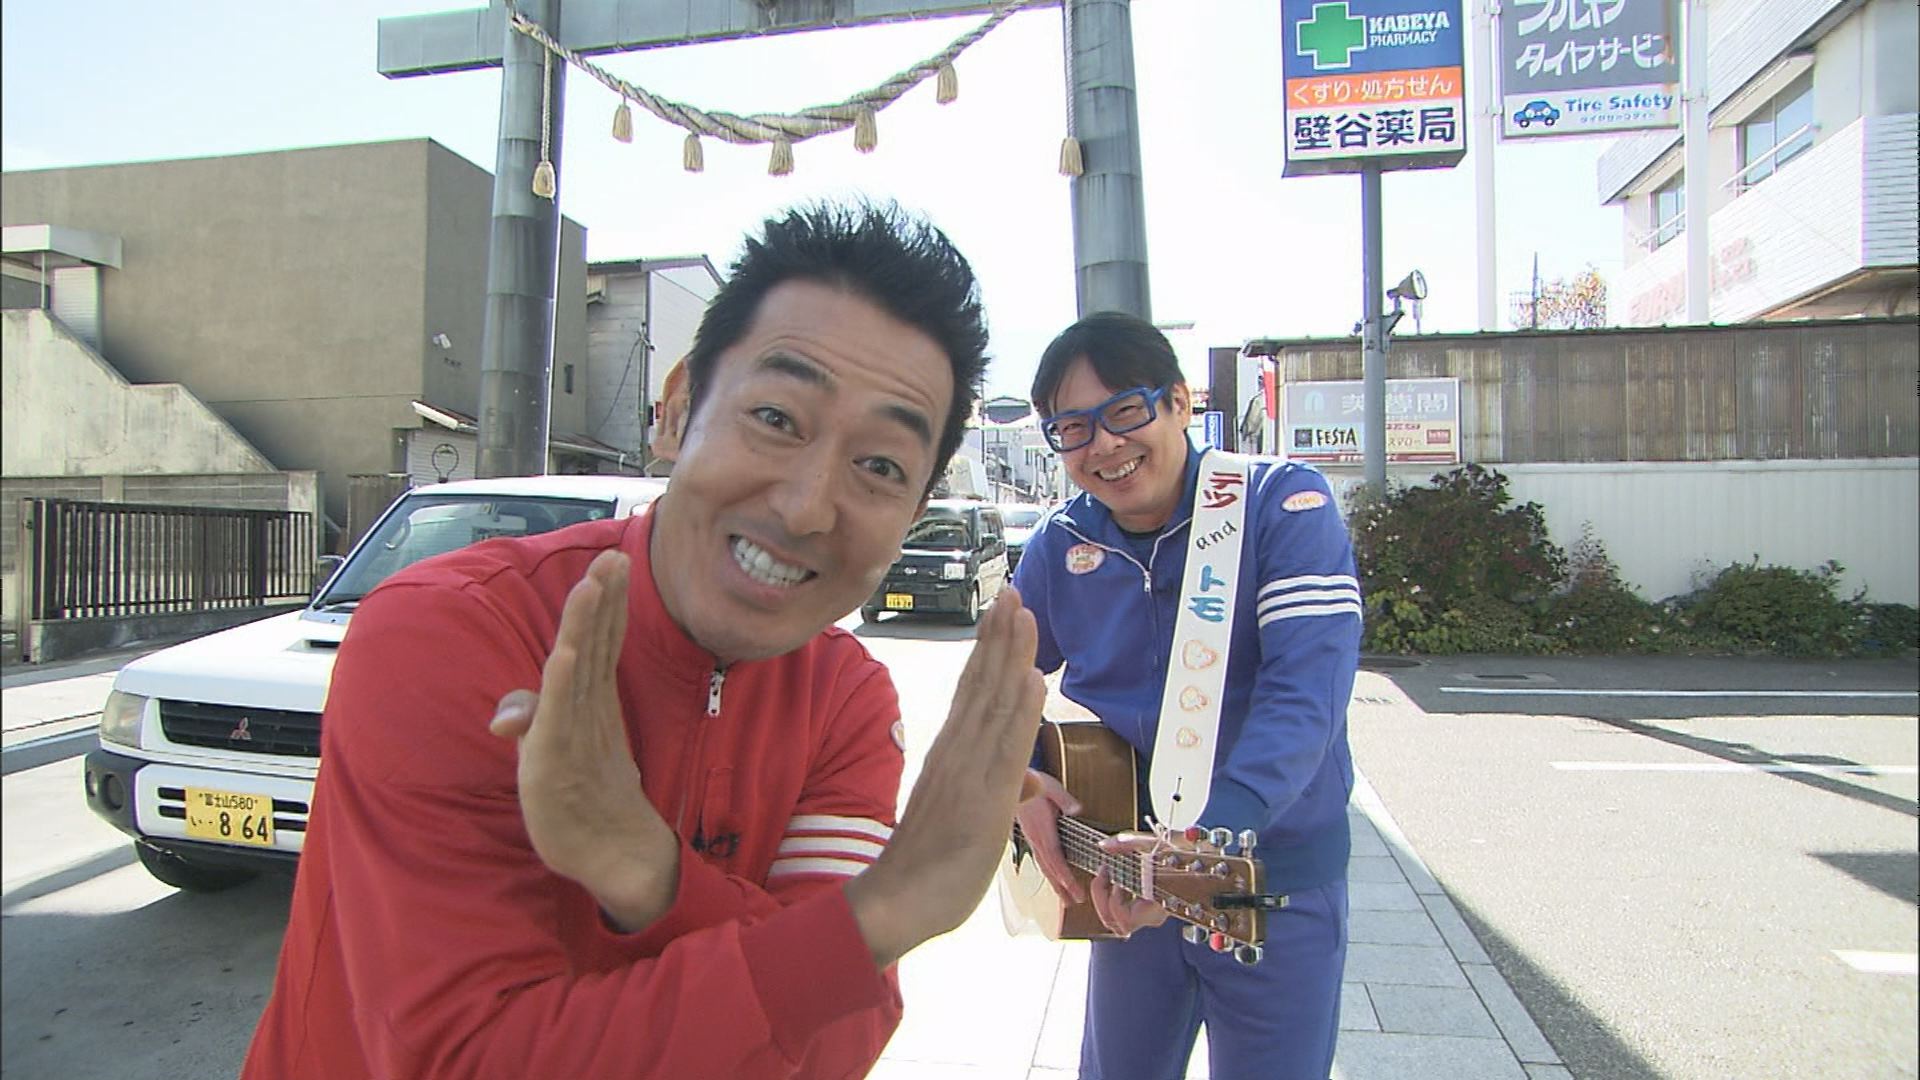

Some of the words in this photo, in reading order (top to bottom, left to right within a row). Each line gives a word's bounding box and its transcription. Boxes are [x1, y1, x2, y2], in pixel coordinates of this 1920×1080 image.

[1369, 11, 1449, 33] KABEYA
[1370, 31, 1437, 47] PHARMACY
[1516, 34, 1674, 78] タイヤサービス
[1294, 74, 1452, 104] くすり・処方せん
[1565, 98, 1602, 112] Tire
[1610, 93, 1673, 110] Safety
[1294, 107, 1456, 150] 壁谷薬局
[1316, 427, 1357, 447] FESTA
[1196, 520, 1237, 550] and
[1188, 565, 1225, 622] トモ
